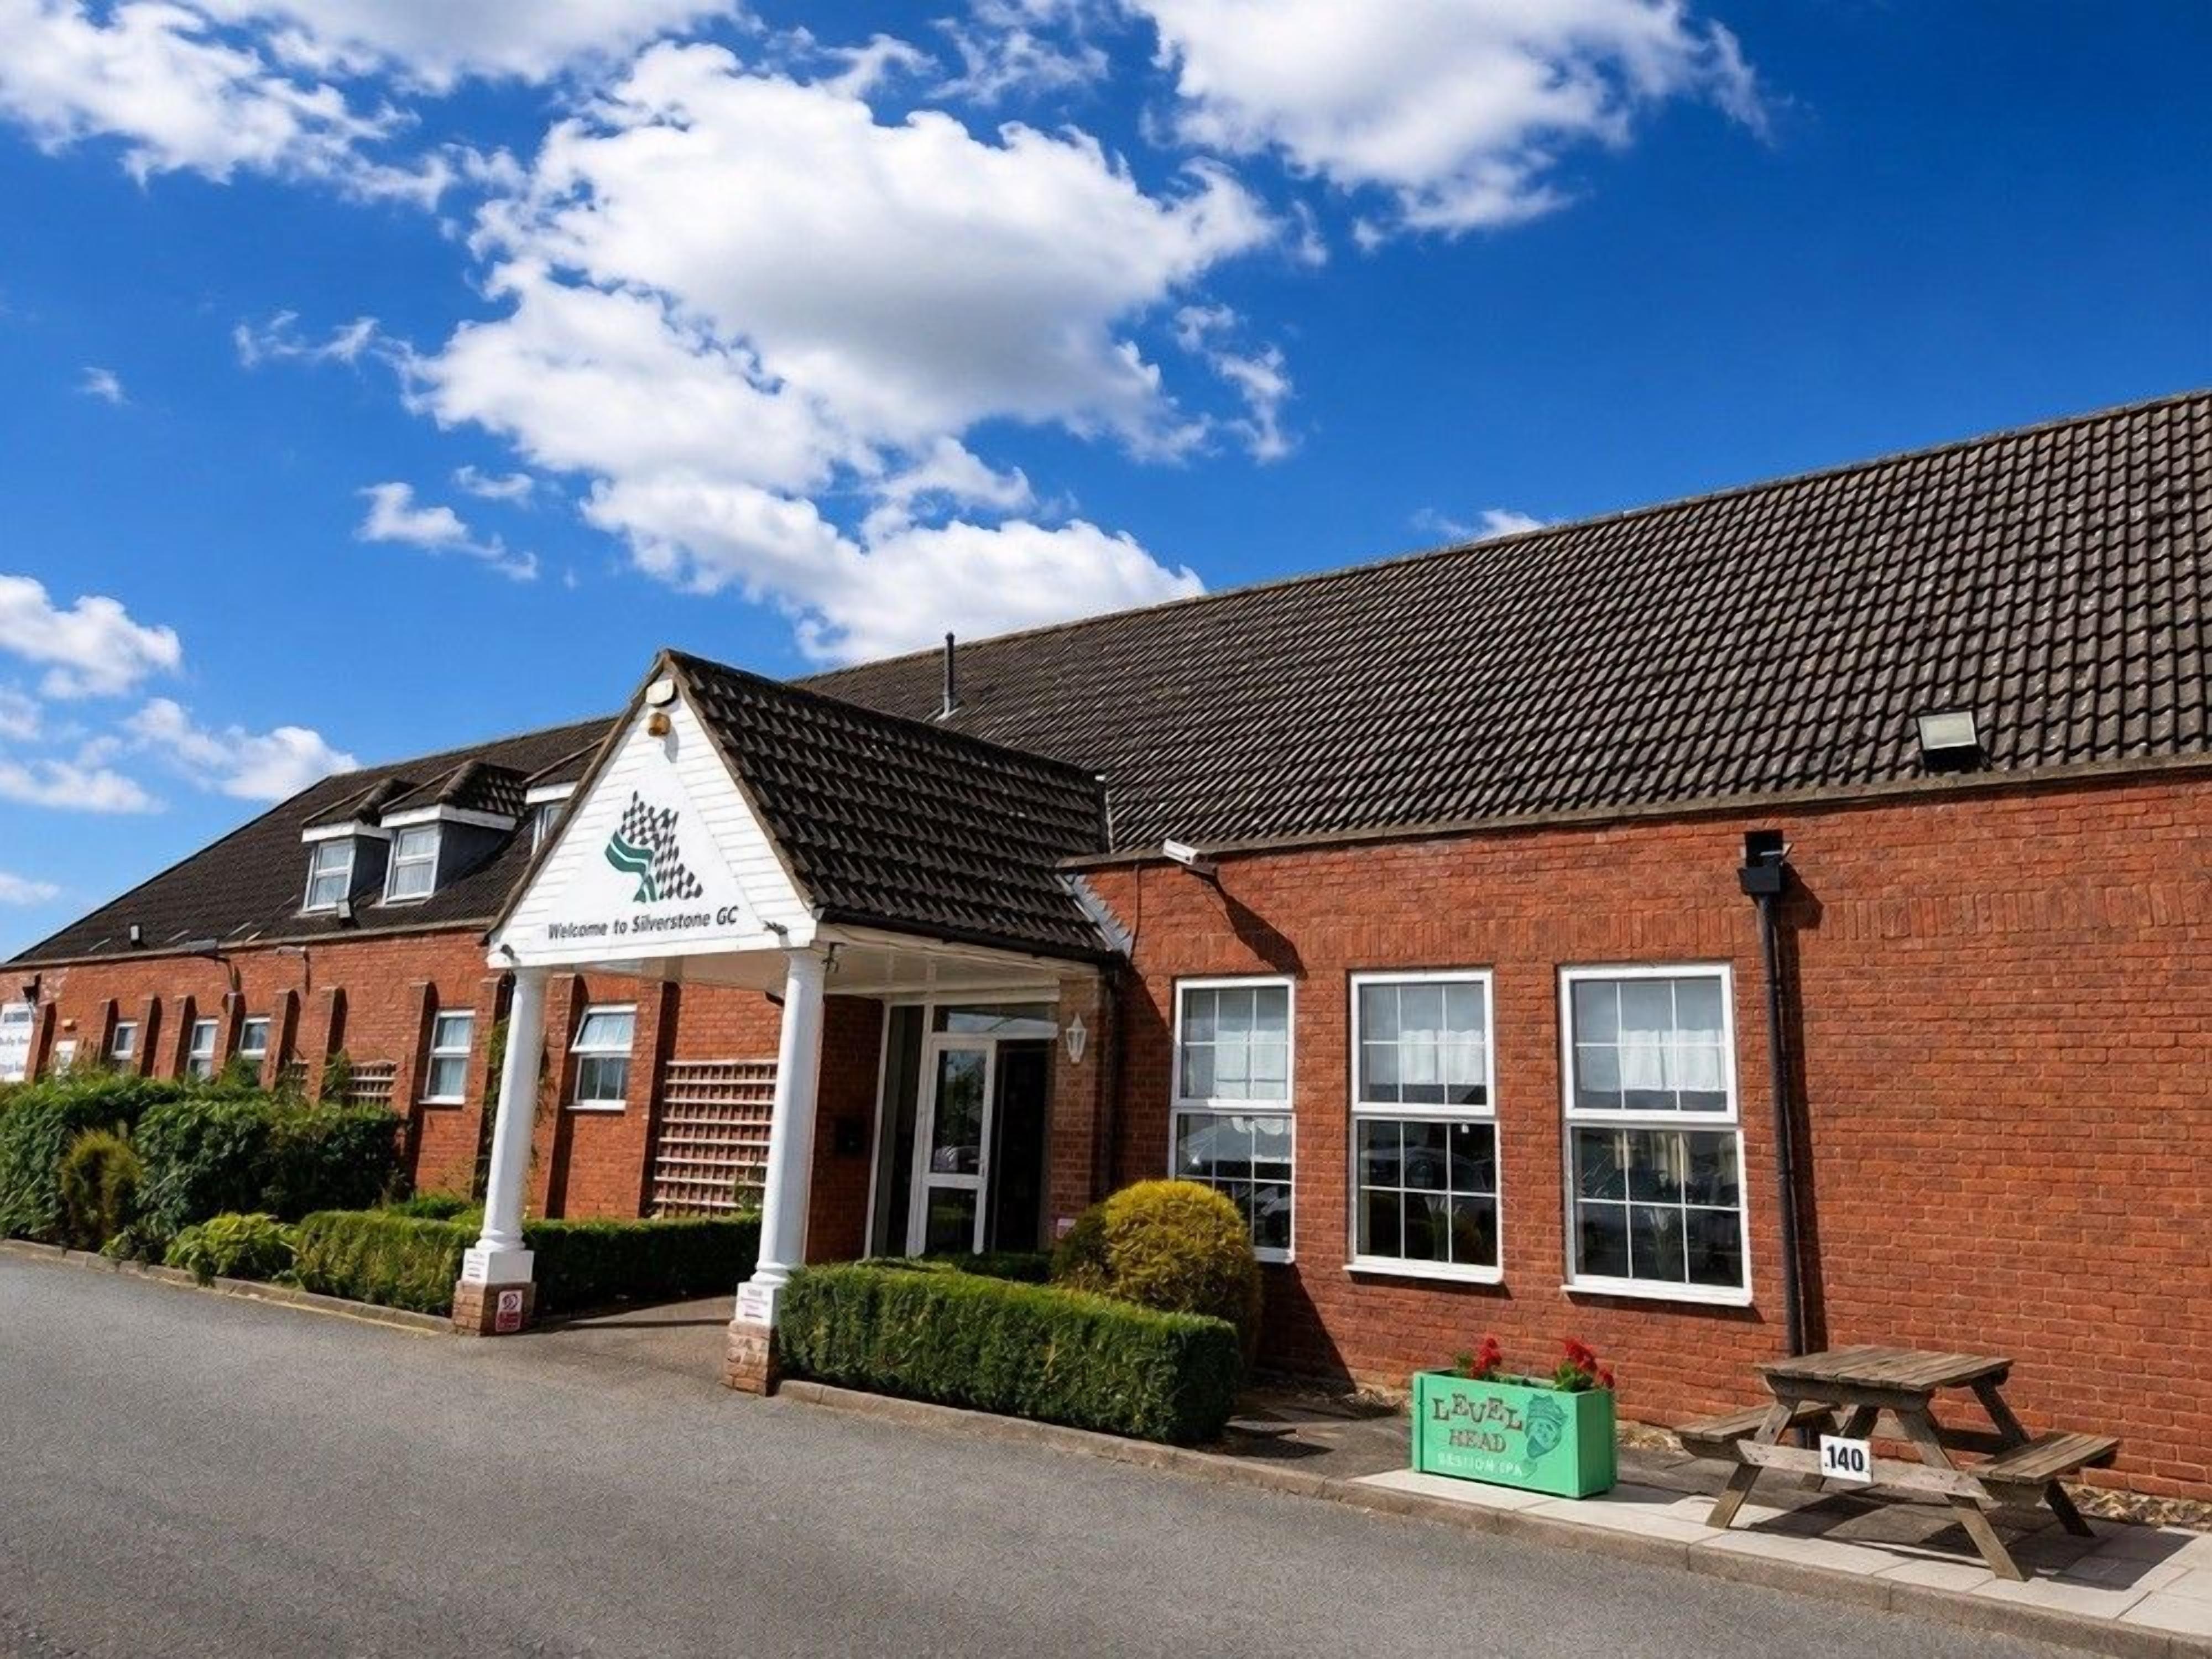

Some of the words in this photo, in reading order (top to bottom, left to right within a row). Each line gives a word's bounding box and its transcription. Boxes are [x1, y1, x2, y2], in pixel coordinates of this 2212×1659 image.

[548, 922, 608, 940] Welcome
[613, 919, 628, 935] to
[632, 913, 711, 933] Silverstone
[716, 905, 739, 925] GC
[1432, 1393, 1522, 1431] LEVEL
[1827, 1444, 1864, 1472] 140
